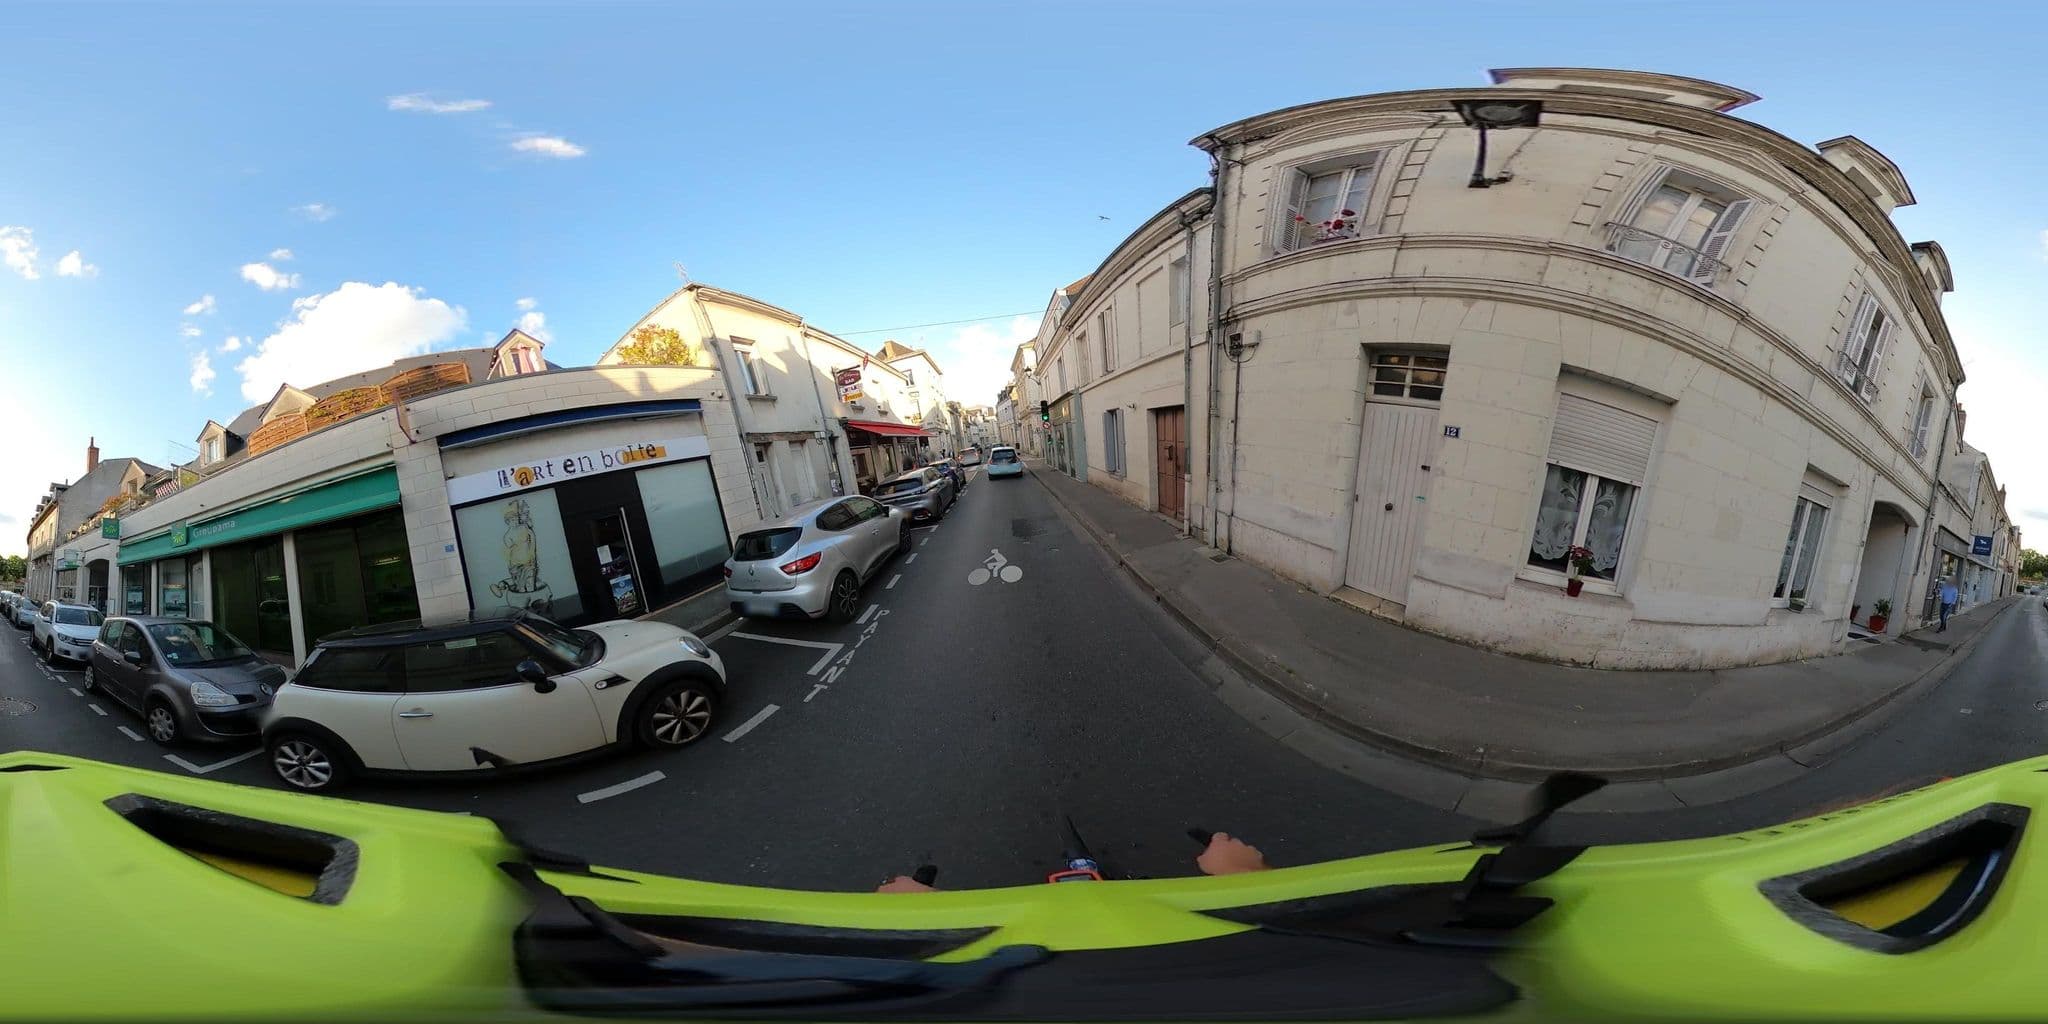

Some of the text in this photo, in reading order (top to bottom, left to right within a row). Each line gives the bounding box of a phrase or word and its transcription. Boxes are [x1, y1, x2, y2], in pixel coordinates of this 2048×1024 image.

[1446, 427, 1457, 436] 12
[563, 455, 594, 474] en
[193, 521, 236, 538] Groupama
[803, 609, 890, 703] PAYANT
